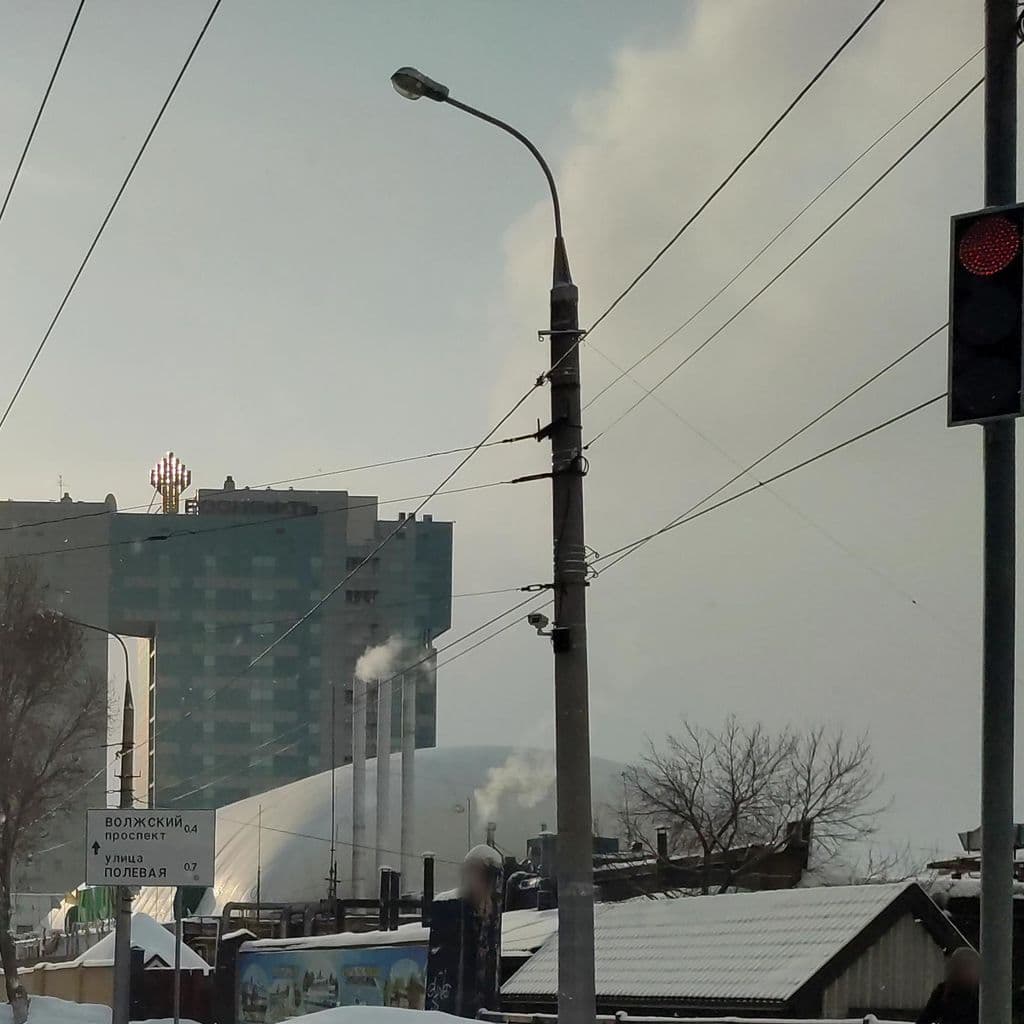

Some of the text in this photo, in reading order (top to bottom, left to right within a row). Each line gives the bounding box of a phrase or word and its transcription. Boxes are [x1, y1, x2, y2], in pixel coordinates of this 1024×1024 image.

[105, 815, 183, 828] ВОЛЖСКИЙ
[105, 831, 166, 842] проспект
[105, 854, 144, 865] улица
[104, 867, 167, 878] ПОЛЕВАЯ
